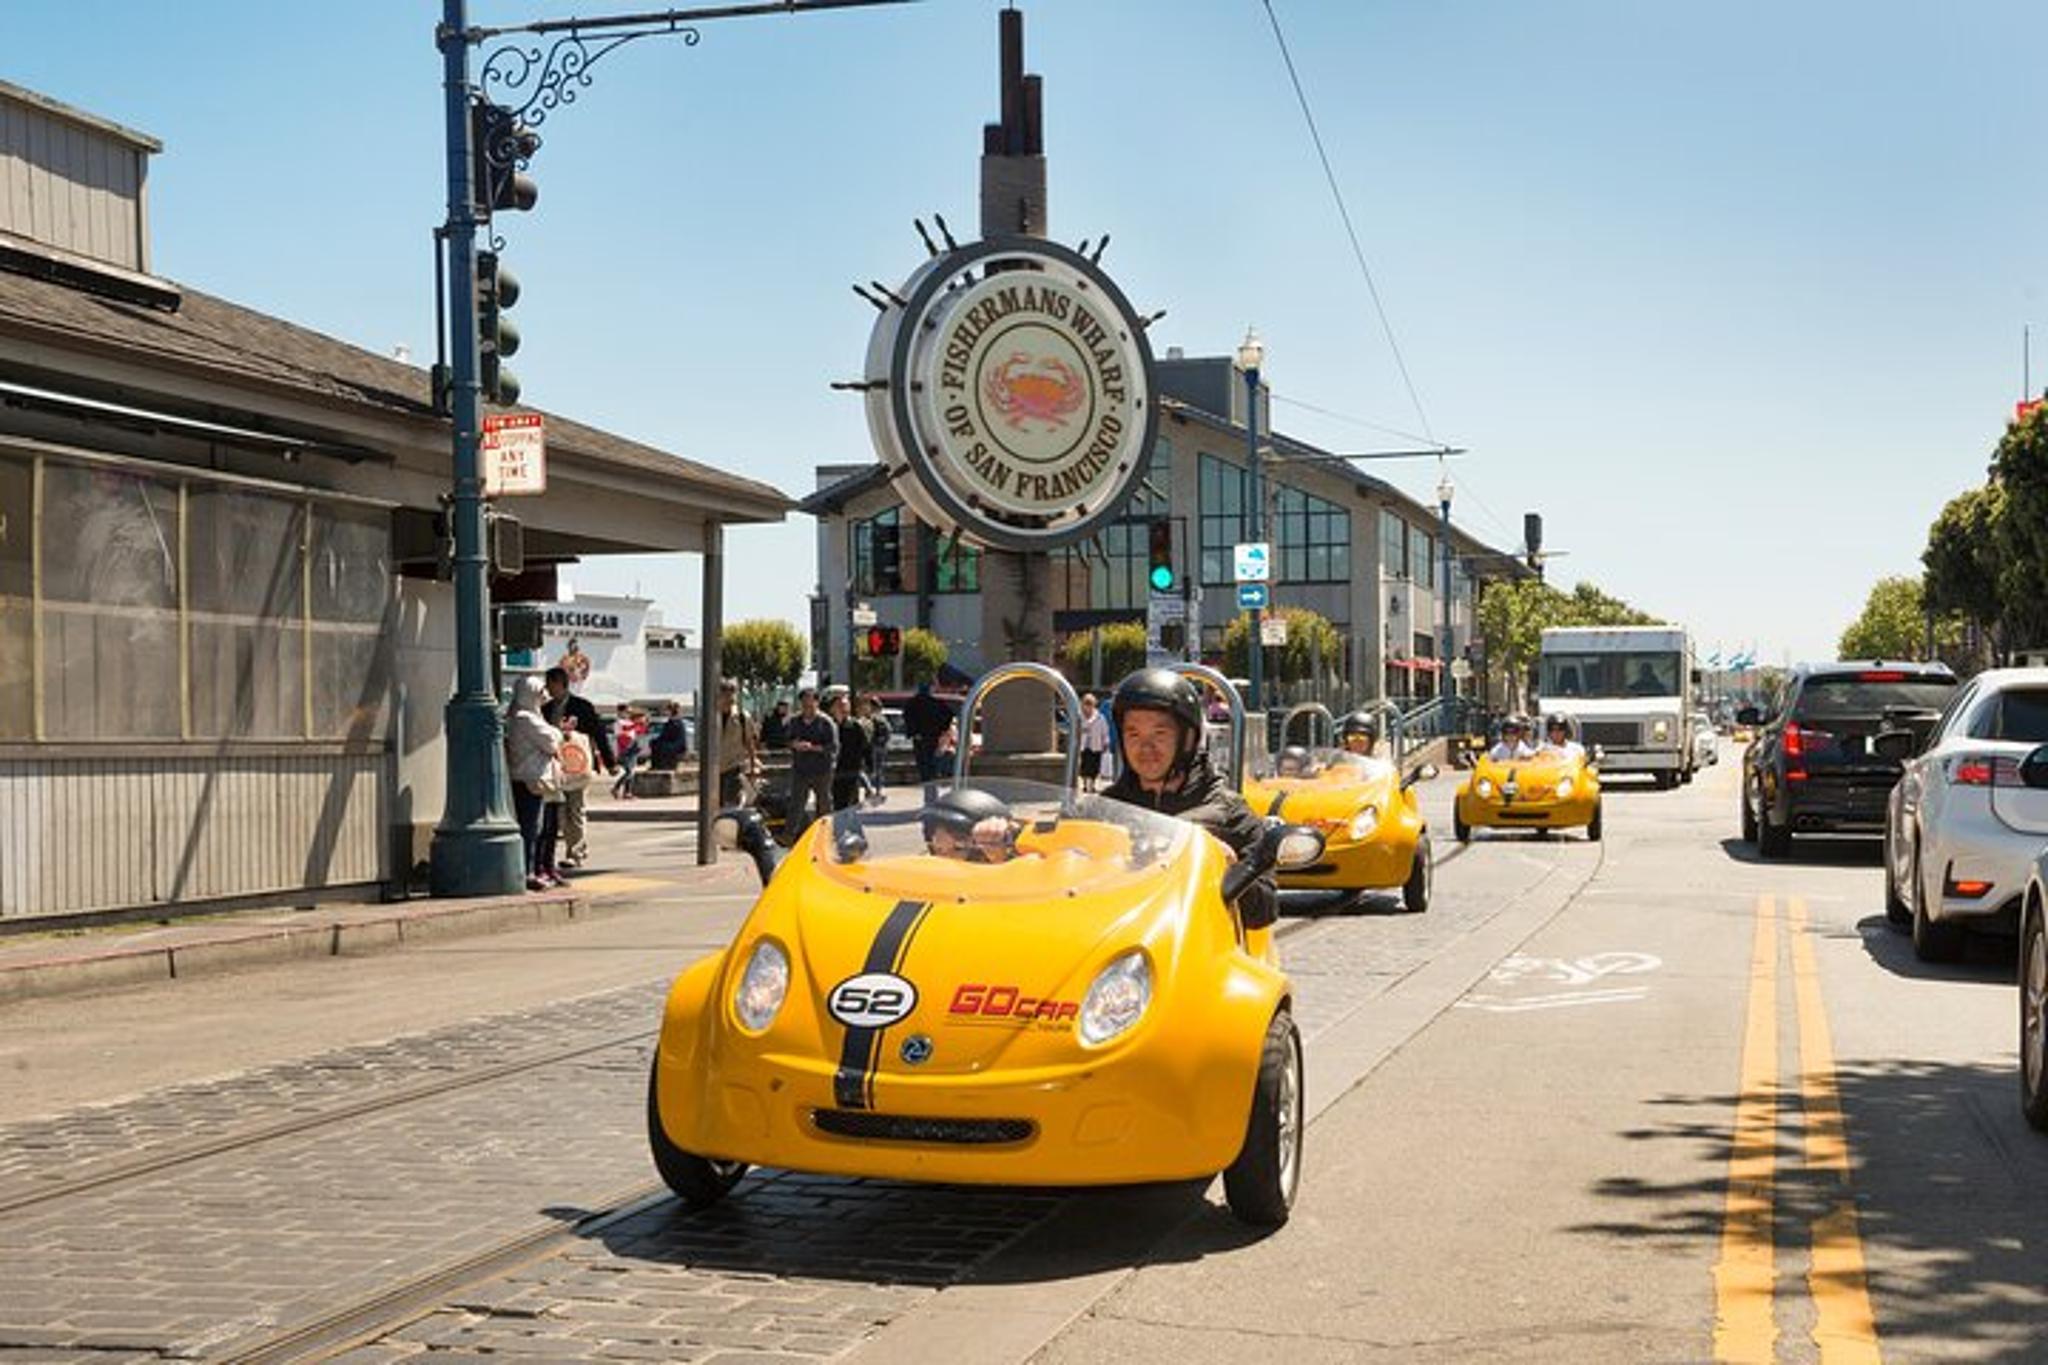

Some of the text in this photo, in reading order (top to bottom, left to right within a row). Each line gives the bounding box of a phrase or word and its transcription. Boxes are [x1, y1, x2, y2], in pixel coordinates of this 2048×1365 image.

[943, 286, 1125, 402] FISHERMANS WHARF
[501, 450, 525, 462] ANY
[944, 404, 1123, 501] OF SAN FRANCISCO
[500, 464, 527, 478] TIME
[836, 988, 904, 1016] 52
